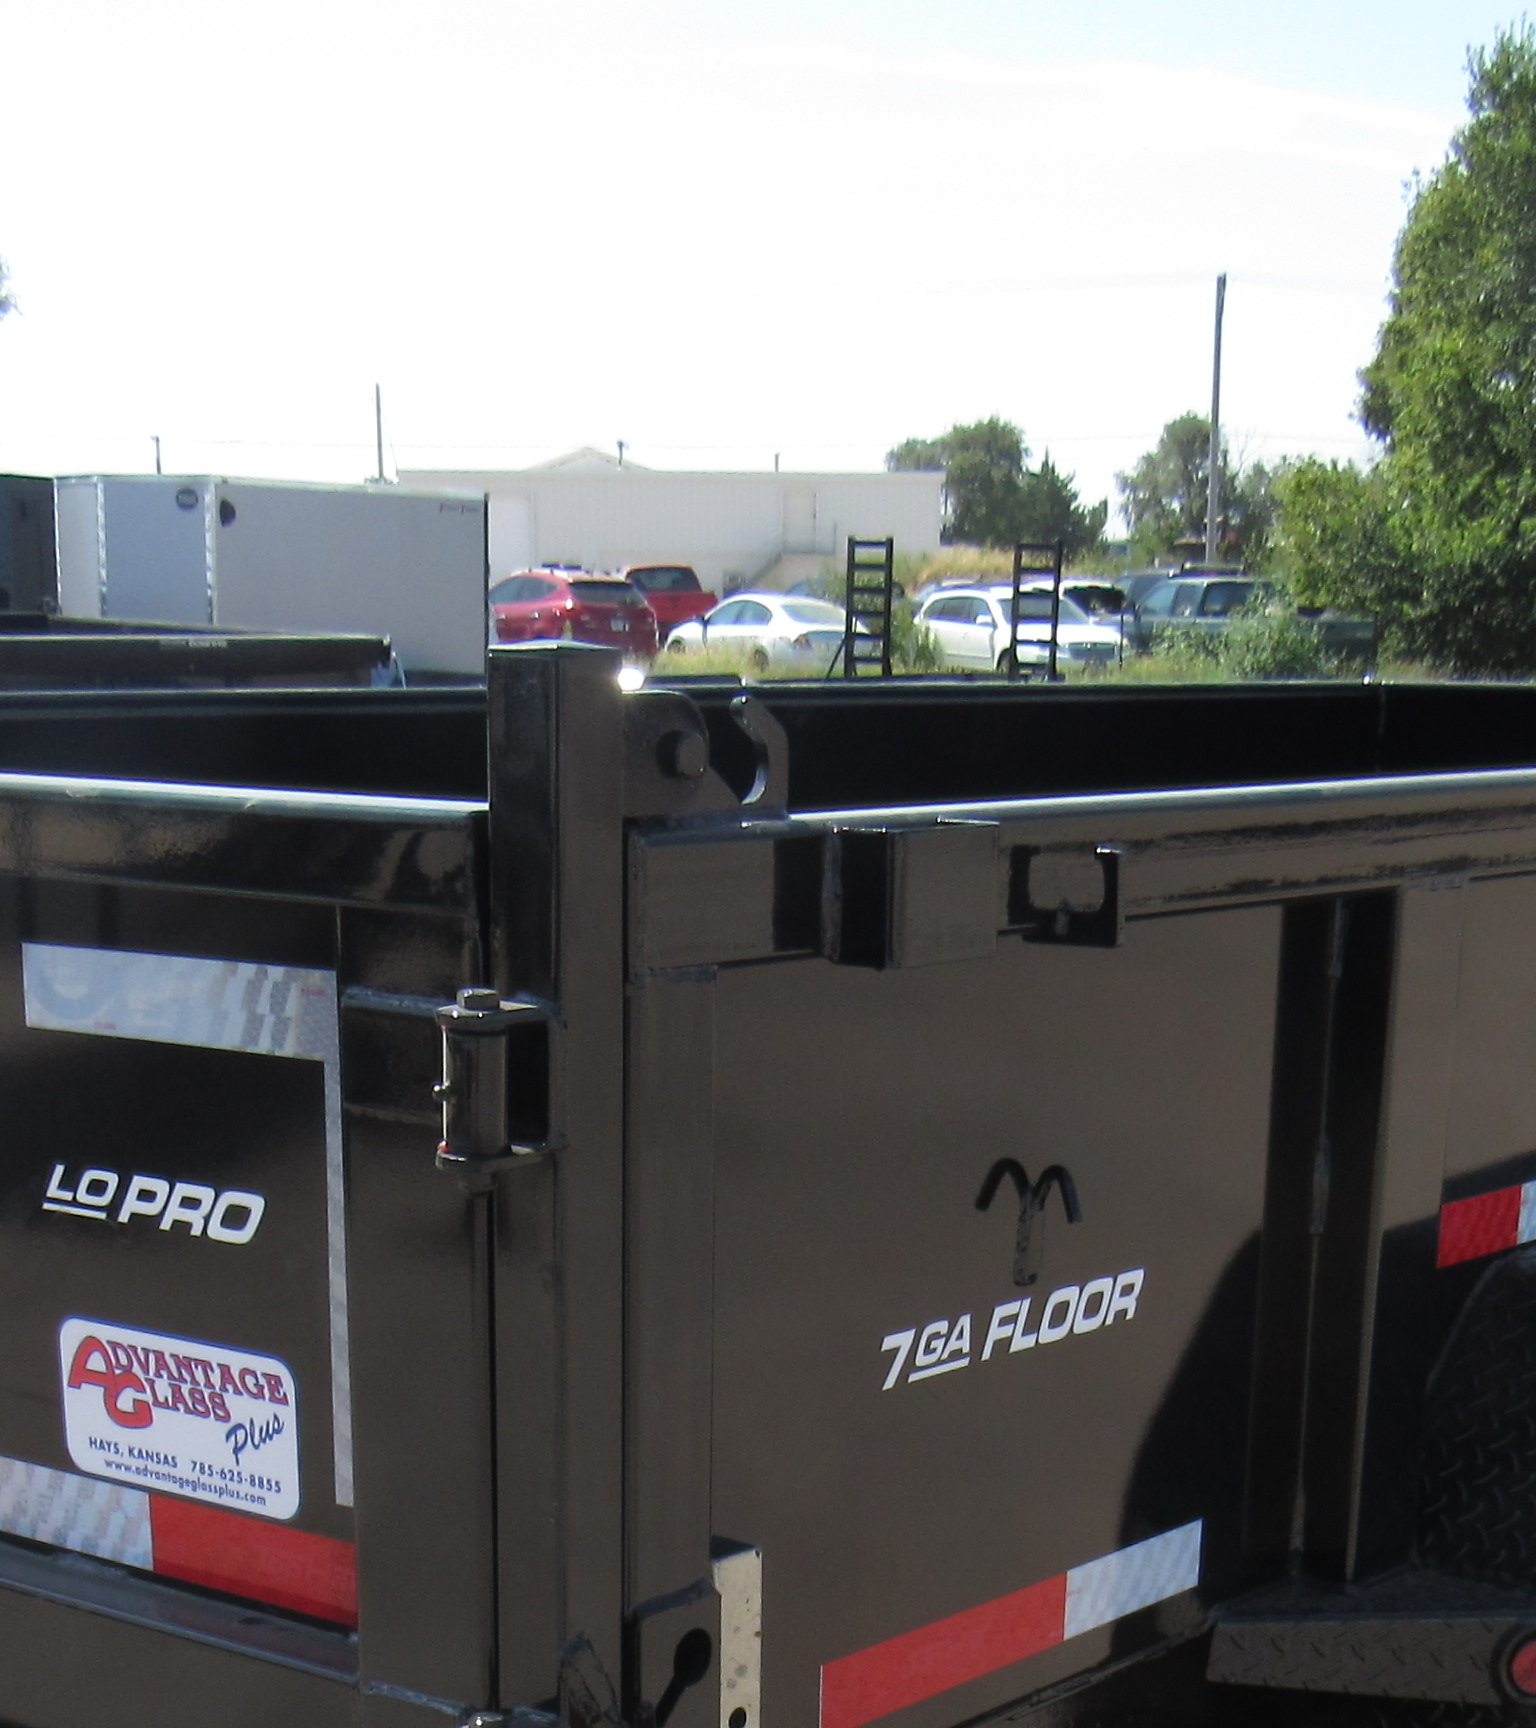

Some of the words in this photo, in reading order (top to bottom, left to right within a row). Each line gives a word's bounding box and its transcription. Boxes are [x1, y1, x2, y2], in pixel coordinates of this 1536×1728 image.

[979, 1266, 1147, 1362] FLOOR
[68, 1335, 290, 1407] ADVANTAGE
[104, 1371, 231, 1429] GLASS
[88, 1436, 124, 1458] HAYS,
[128, 1445, 178, 1469] KANSAS
[190, 1460, 282, 1495] 785-625-8855
[225, 1412, 285, 1467] Plus
[104, 1458, 267, 1507] www.advantageglassplus.com
